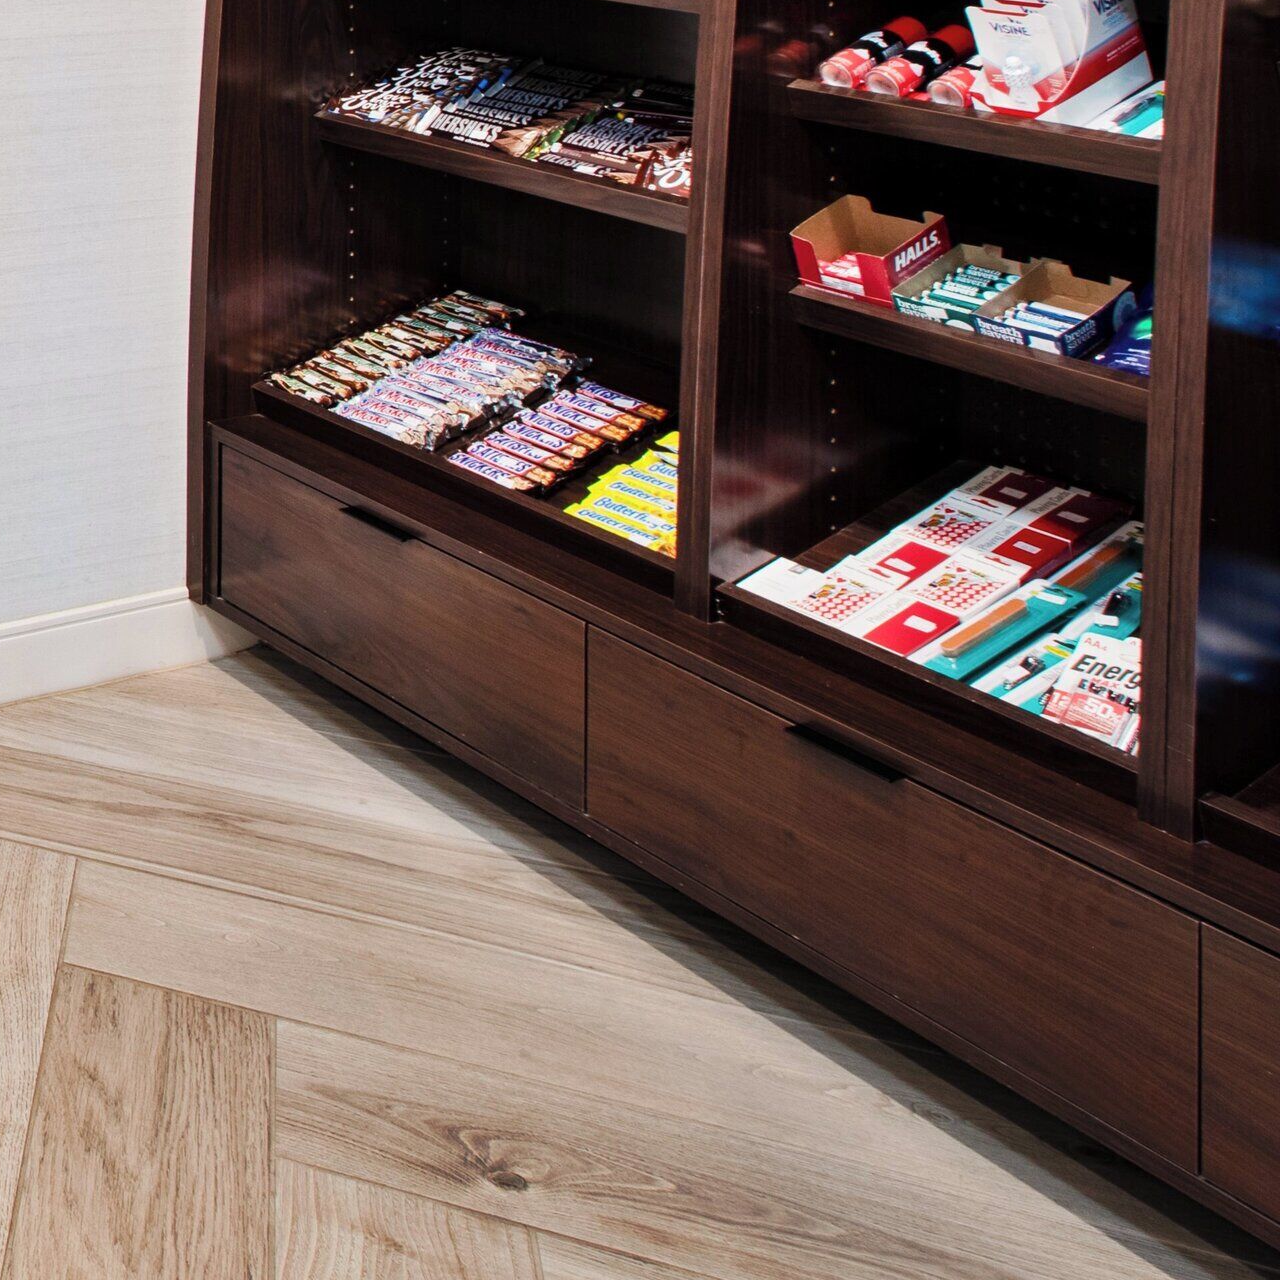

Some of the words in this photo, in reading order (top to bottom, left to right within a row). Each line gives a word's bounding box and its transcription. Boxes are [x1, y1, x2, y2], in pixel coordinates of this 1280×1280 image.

[989, 21, 1032, 37] VISINE
[495, 88, 569, 111] HERSHEY'S
[430, 112, 503, 143] HERSHEY'S
[562, 131, 636, 156] HERSHEY'S
[977, 317, 1023, 339] breath
[981, 328, 1024, 346] savers
[1065, 319, 1096, 344] breath
[544, 402, 596, 429] SNICKE
[559, 393, 613, 418] SNICKS
[508, 421, 563, 449] SNICKS
[520, 409, 577, 437] SNICKERS
[1072, 654, 1140, 689] Energ
